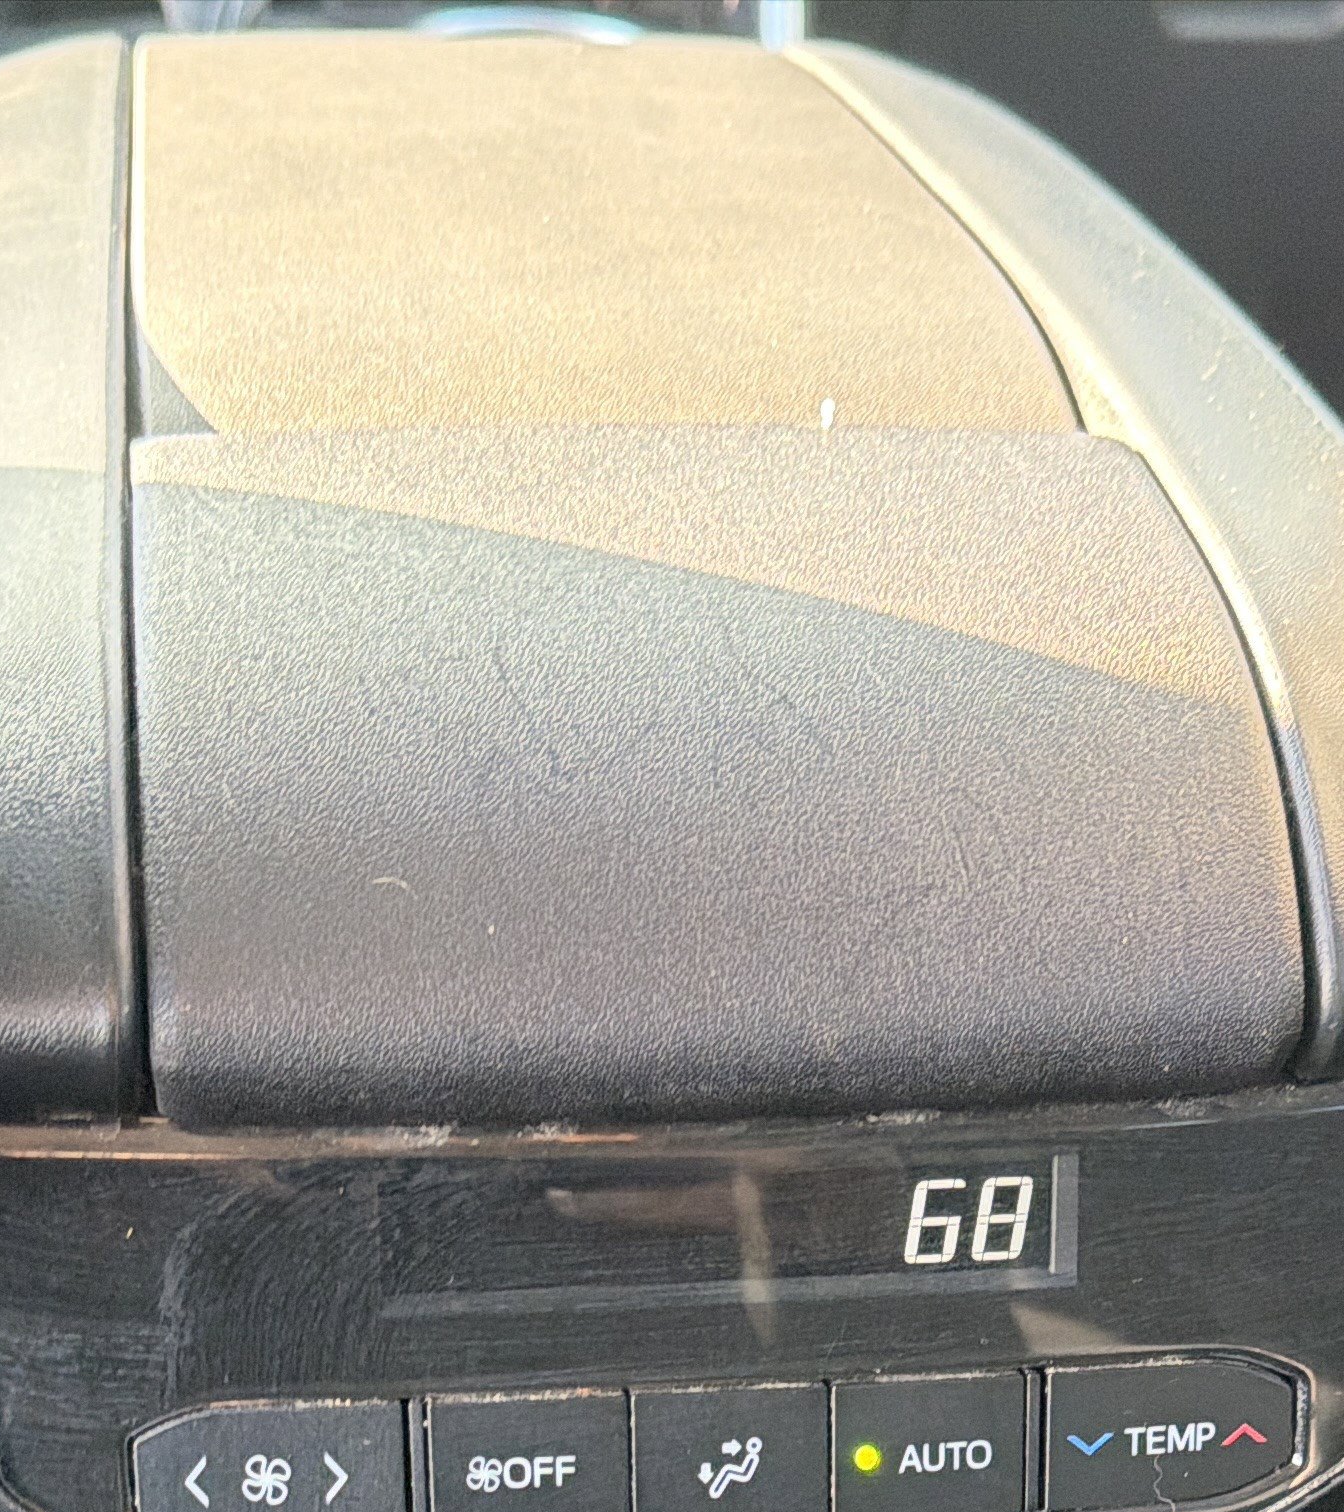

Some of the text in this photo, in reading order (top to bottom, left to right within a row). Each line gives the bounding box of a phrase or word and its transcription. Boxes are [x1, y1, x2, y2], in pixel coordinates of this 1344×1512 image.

[903, 1175, 1034, 1265] 68
[898, 1439, 993, 1475] AUTO
[1123, 1421, 1216, 1457] TEMP
[503, 1454, 577, 1489] OFF
